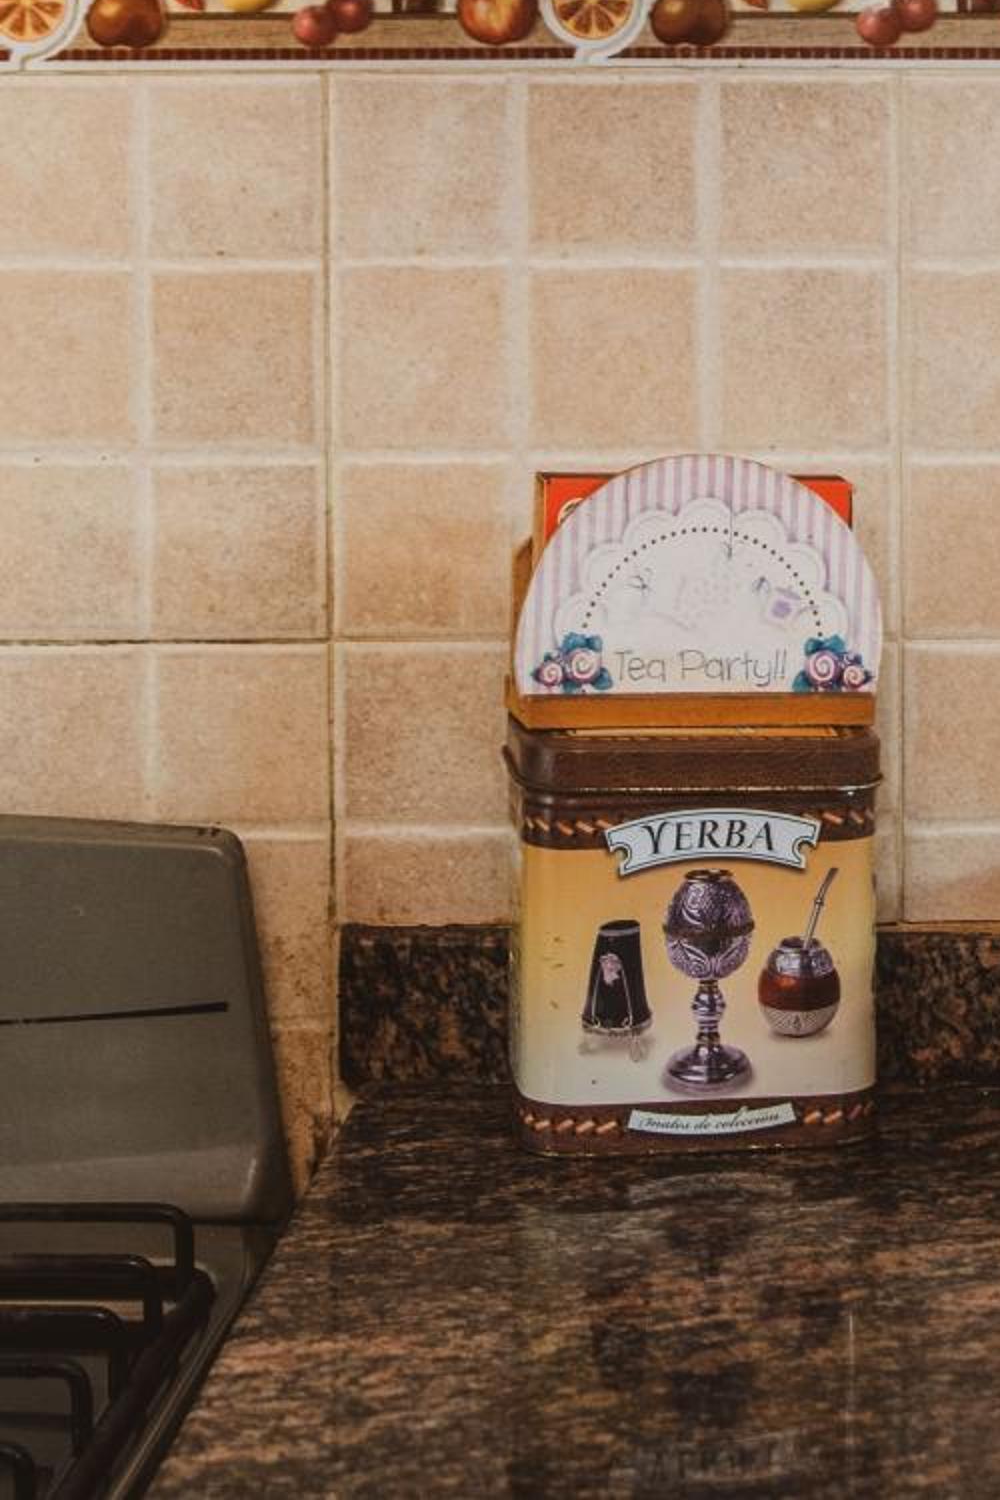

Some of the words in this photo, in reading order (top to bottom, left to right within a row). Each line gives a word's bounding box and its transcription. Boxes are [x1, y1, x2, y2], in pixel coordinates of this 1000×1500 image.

[614, 649, 666, 682] Tea
[678, 648, 788, 688] Party!!
[641, 818, 775, 855] YERBA
